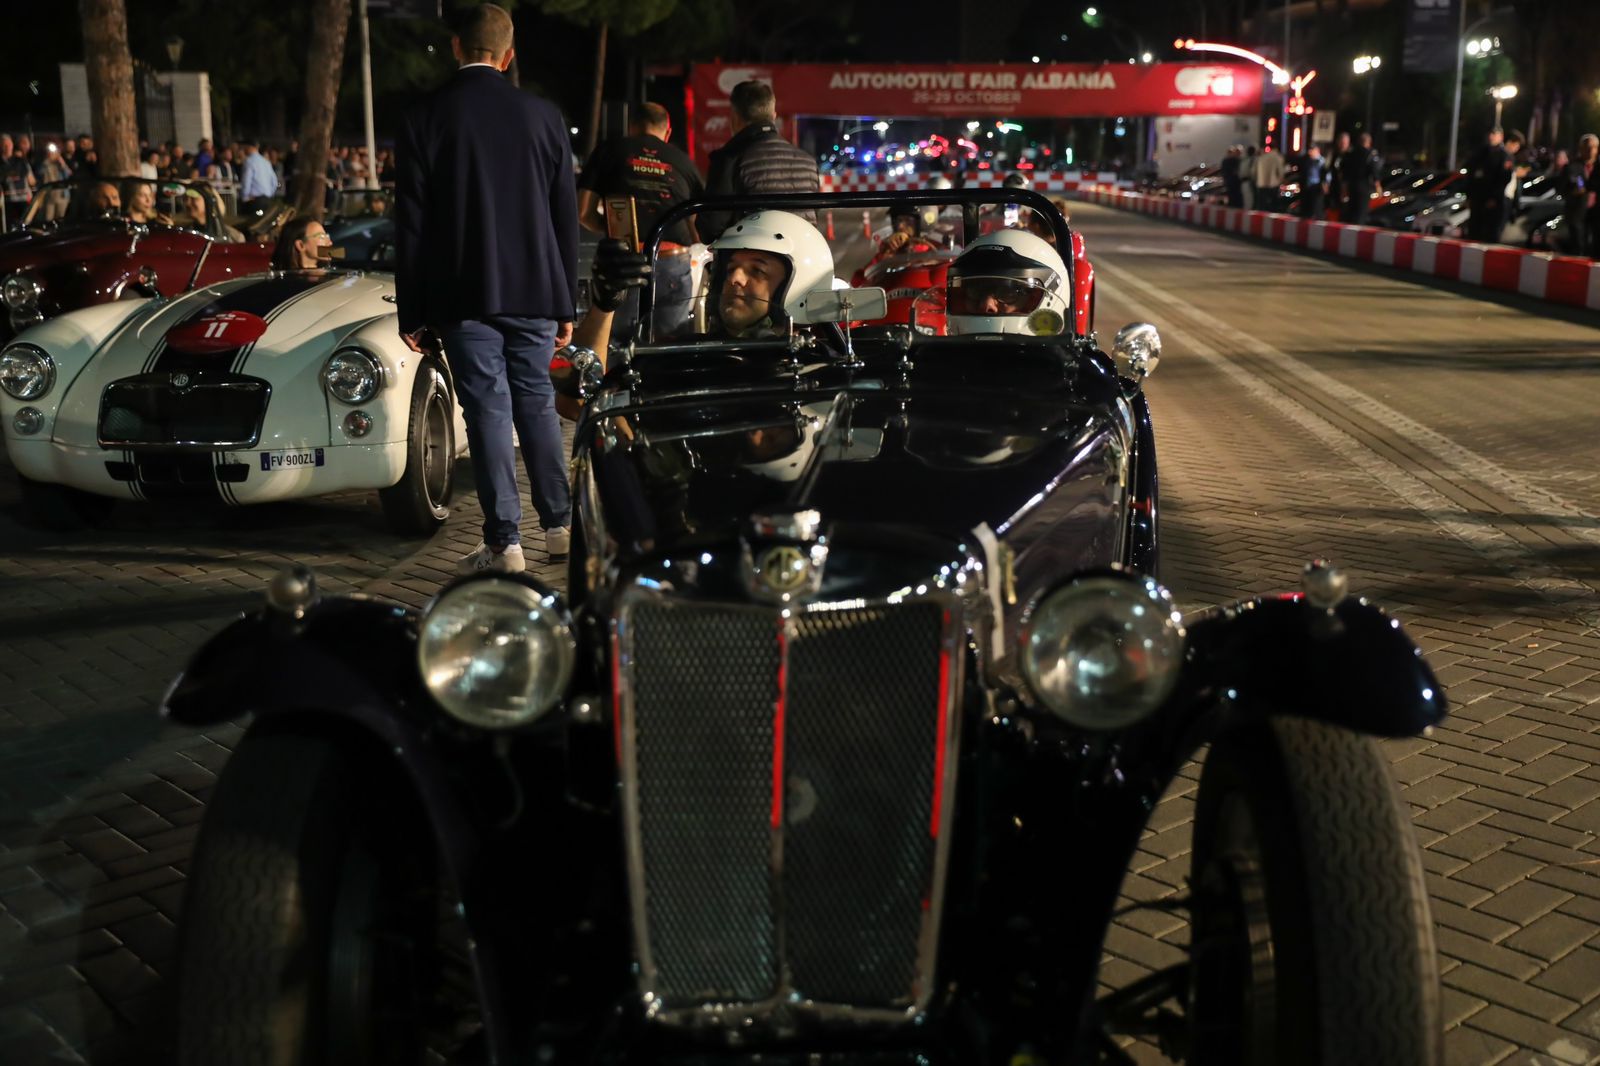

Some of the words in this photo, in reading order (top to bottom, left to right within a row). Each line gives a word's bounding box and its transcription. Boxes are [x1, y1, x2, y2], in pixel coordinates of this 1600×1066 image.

[829, 72, 964, 90] AUTOMOTIVE
[969, 72, 1016, 90] FAIR
[1022, 71, 1116, 90] ALBANIA
[954, 90, 1021, 104] OCTOBER
[633, 165, 666, 176] HOURS
[204, 321, 229, 339] 11
[270, 455, 283, 467] FV
[285, 453, 315, 466] 900ZL
